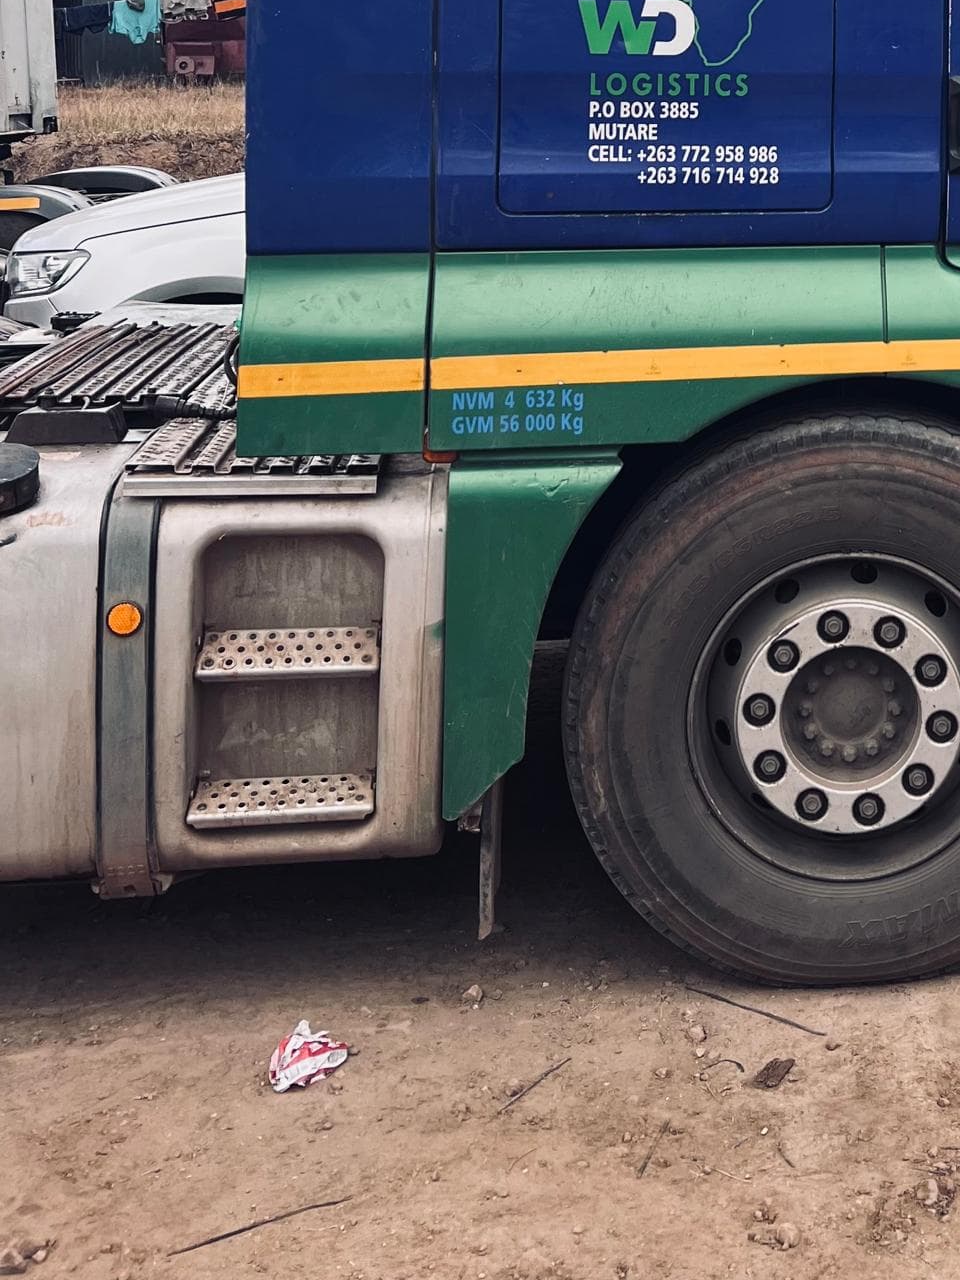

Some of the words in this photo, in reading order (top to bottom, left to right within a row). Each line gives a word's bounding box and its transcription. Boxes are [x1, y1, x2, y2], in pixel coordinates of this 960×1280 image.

[588, 72, 750, 97] LOGISTICS
[588, 101, 615, 119] P.O
[619, 101, 655, 119] BOX
[659, 102, 699, 119] 3885
[588, 123, 658, 141] MUTARE
[587, 145, 632, 162] CELL:
[636, 145, 676, 163] +263
[681, 145, 710, 163] 772
[715, 146, 744, 163] 958
[748, 146, 778, 163] 986
[637, 167, 676, 184] +263
[682, 167, 711, 184] 716
[716, 167, 745, 184] 714
[749, 167, 780, 184] 928
[451, 391, 494, 411] NVM
[504, 391, 515, 409] 4
[525, 389, 556, 408] 632
[561, 389, 584, 412] Kg
[451, 416, 494, 435] GVM
[499, 414, 519, 433] 56
[525, 413, 556, 432] 000
[561, 413, 583, 435] Kg
